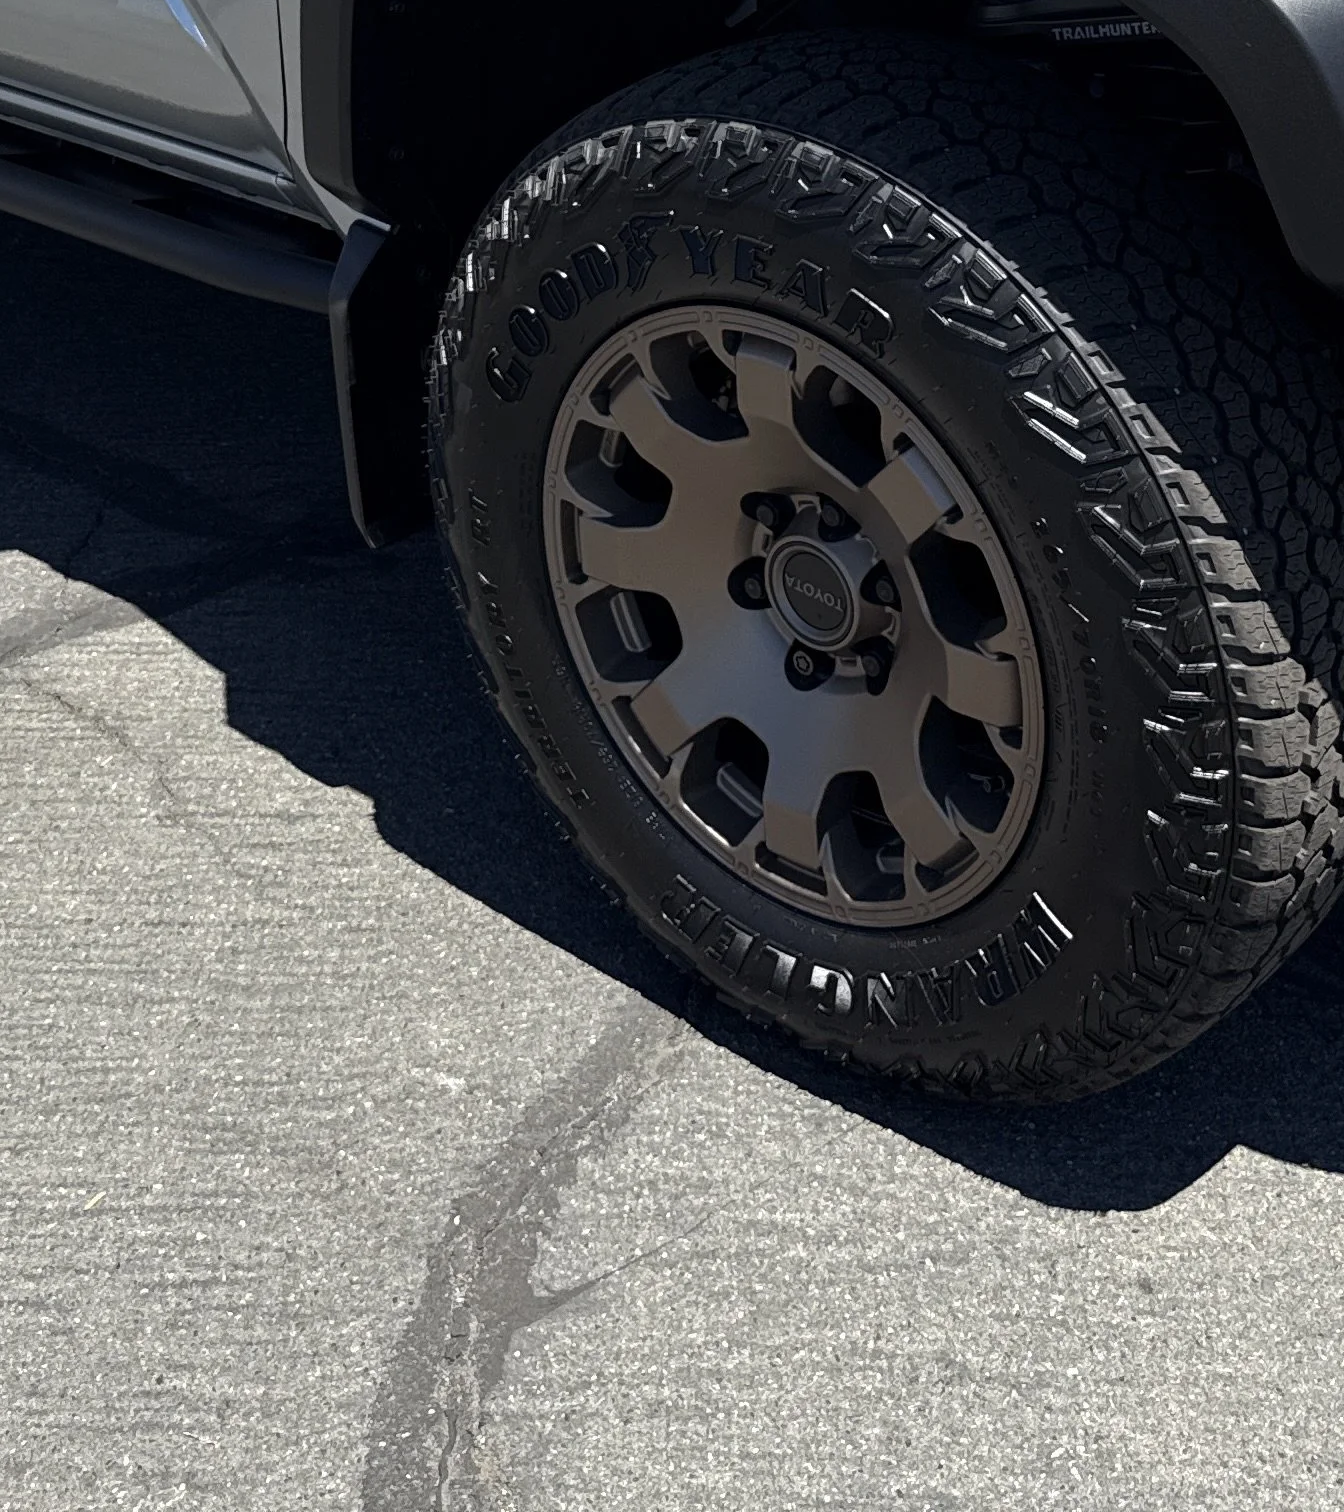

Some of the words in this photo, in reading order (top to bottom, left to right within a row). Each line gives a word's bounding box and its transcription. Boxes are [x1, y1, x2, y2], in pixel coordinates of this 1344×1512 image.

[486, 210, 895, 403] GOODYEAR
[784, 573, 844, 613] TOYOTA
[476, 570, 591, 809] TERRITORY
[661, 874, 1073, 1029] WRANGLER
